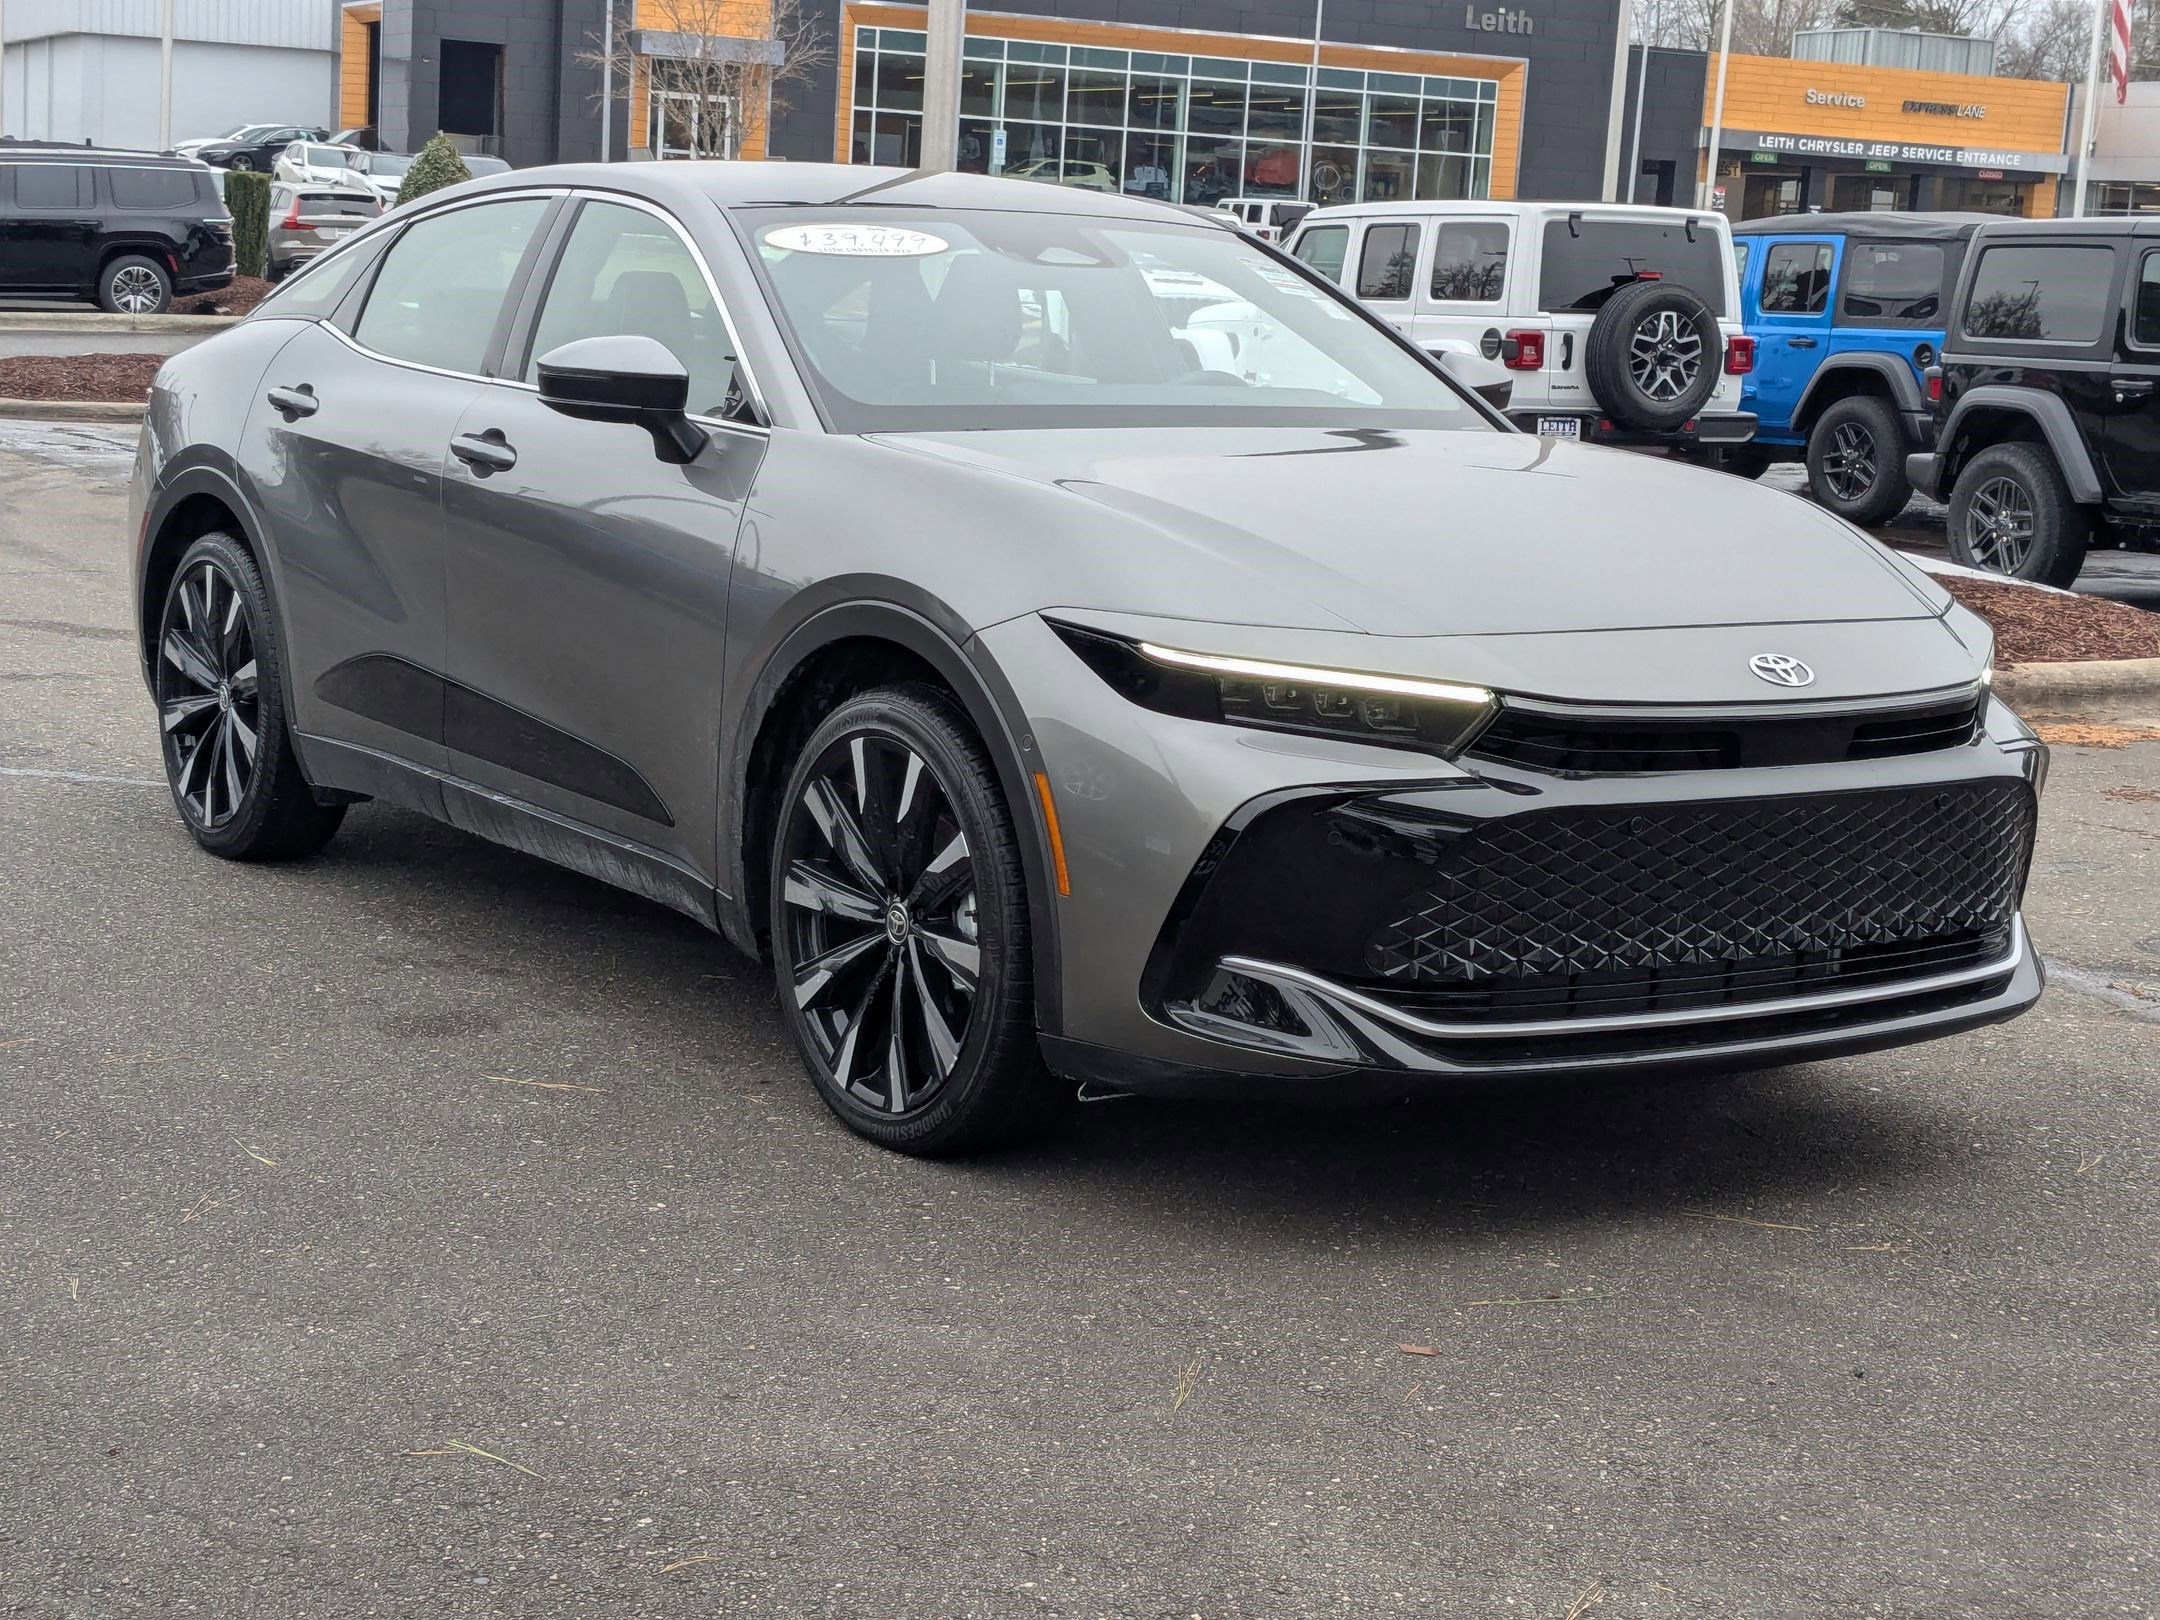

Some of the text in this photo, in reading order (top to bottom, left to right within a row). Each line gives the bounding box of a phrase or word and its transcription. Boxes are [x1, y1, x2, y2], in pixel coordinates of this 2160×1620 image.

[1465, 5, 1533, 34] Leith
[1806, 88, 1865, 108] Service
[1754, 152, 1775, 161] OPEN
[1759, 136, 2020, 165] LEITH CHRYSLER JEEP SERVICE ENTRANCE
[1869, 162, 1889, 171] OPEN
[871, 1100, 953, 1141] BRIDGESTONE
